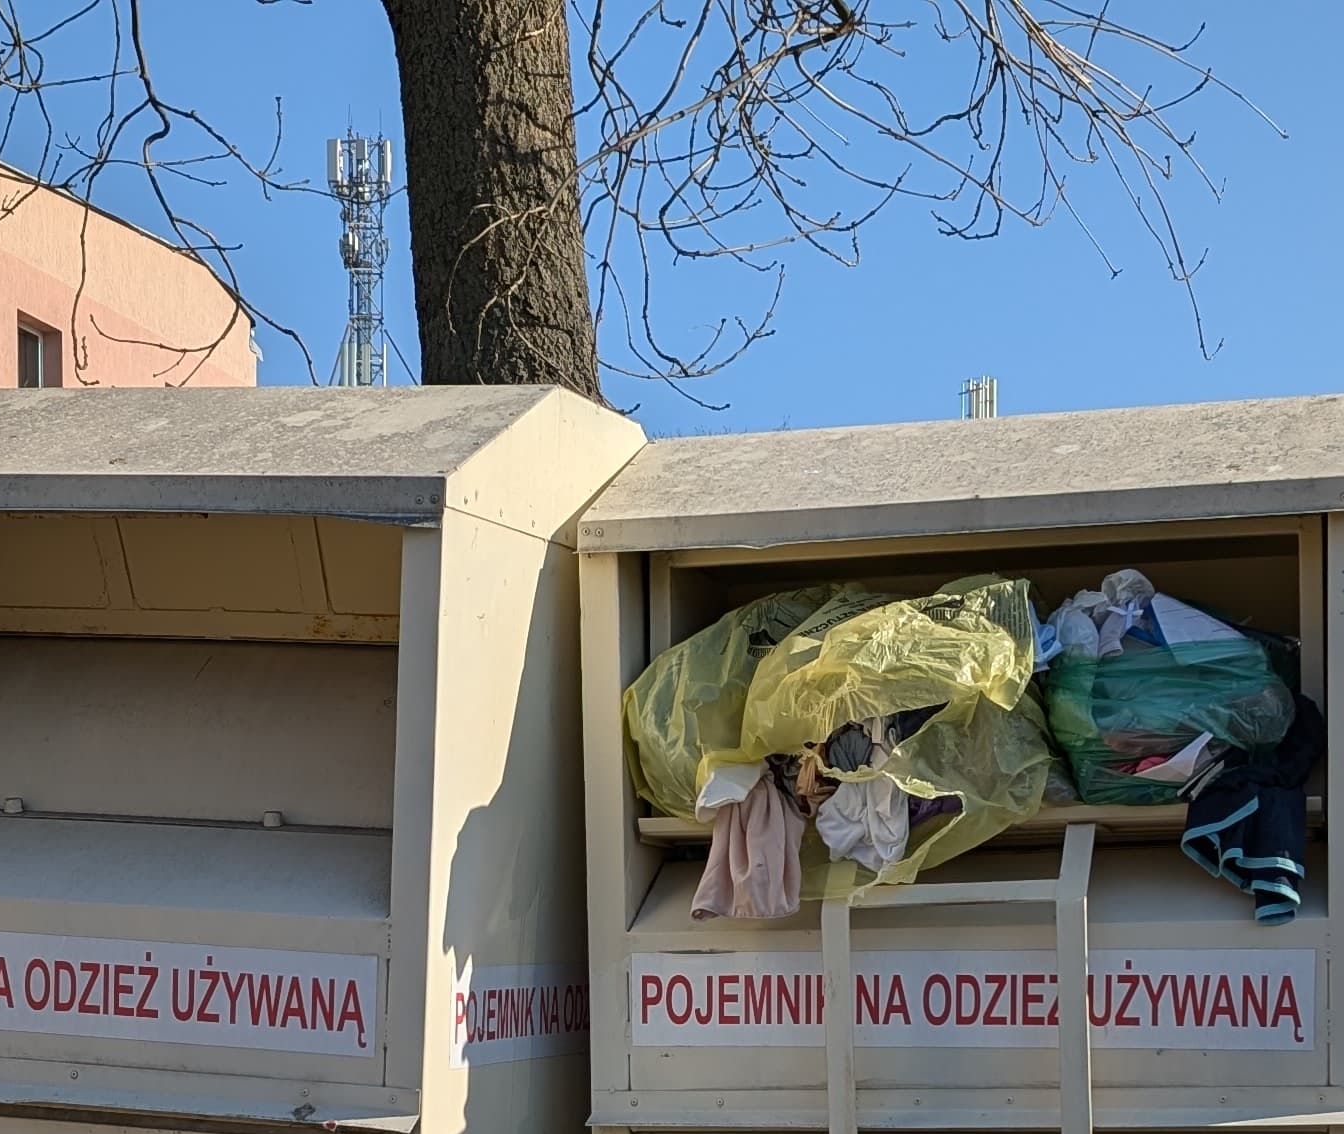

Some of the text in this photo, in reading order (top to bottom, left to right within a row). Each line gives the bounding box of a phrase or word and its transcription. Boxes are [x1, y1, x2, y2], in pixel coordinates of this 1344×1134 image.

[24, 951, 159, 1019] ODZIEŻ
[171, 956, 367, 1049] UŻYWANĄ
[455, 986, 537, 1044] POJEMNIK
[539, 985, 560, 1036] NA
[856, 974, 912, 1025] NA
[1087, 959, 1305, 1043] UŻYWANĄ
